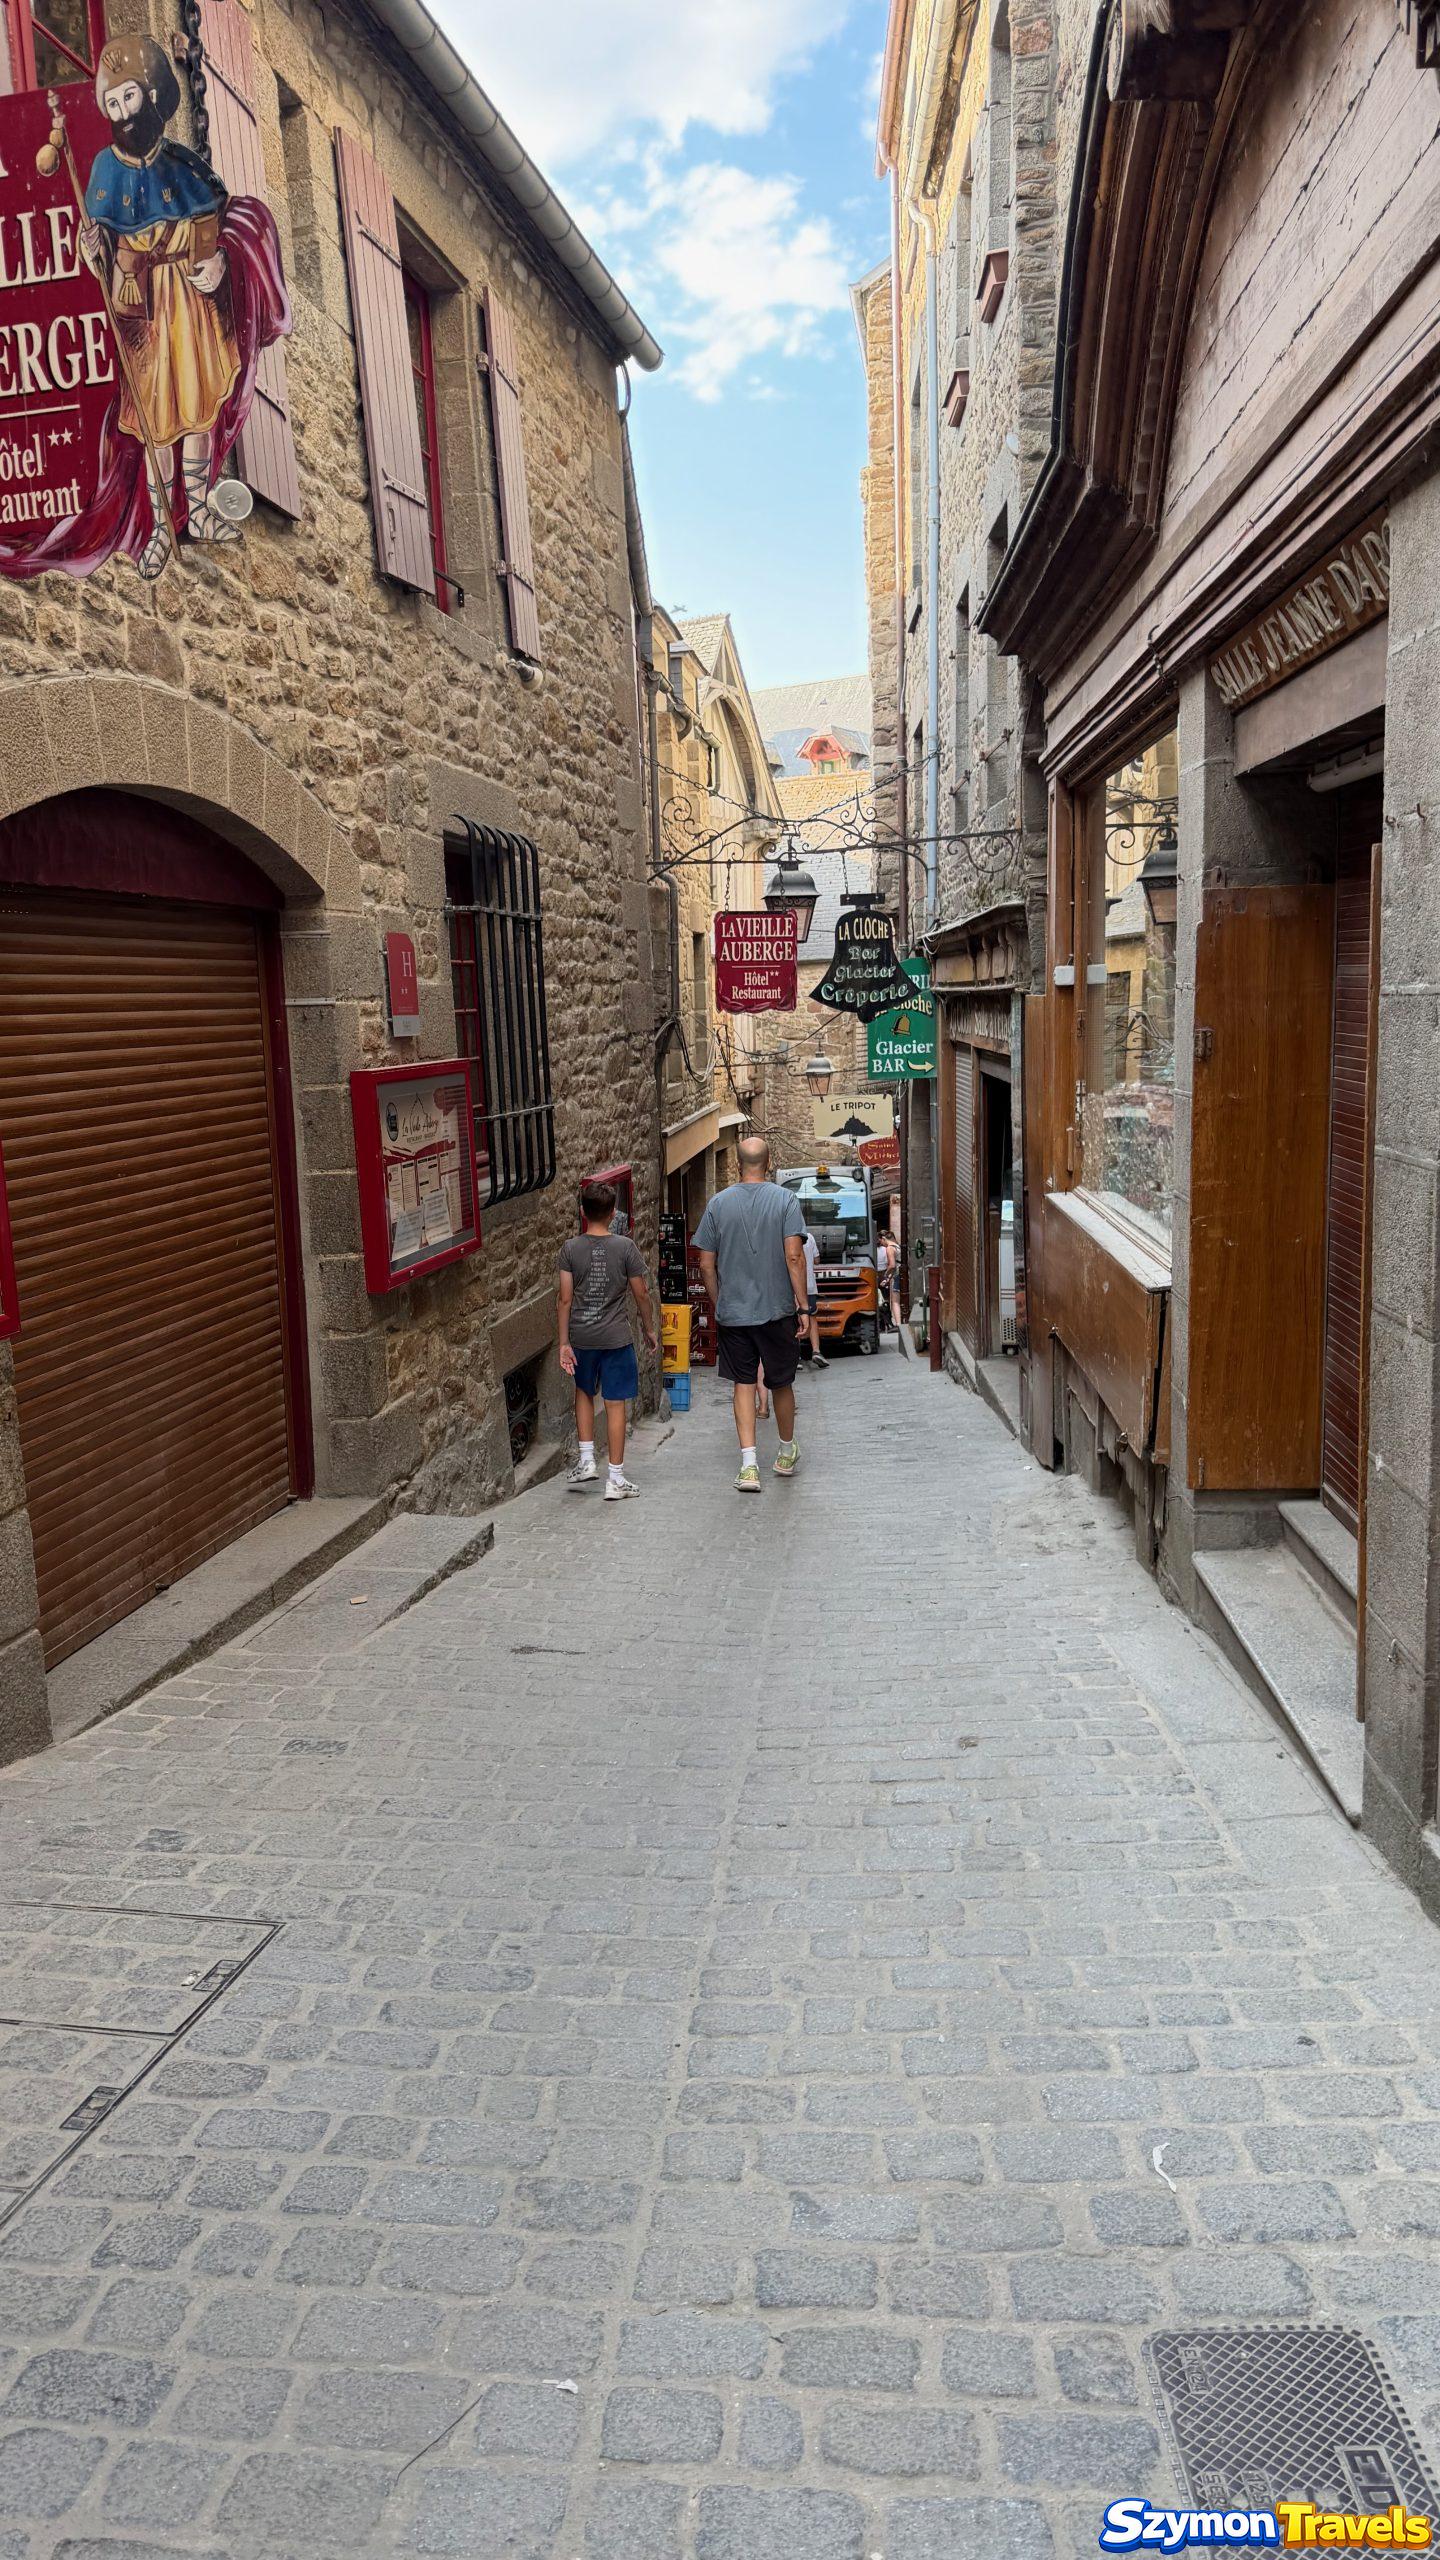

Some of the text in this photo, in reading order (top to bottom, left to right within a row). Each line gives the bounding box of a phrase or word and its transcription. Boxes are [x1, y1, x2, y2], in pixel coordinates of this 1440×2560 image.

[0, 478, 83, 524] aurant
[1210, 638, 1268, 704] SALLE
[1258, 575, 1346, 672] JEANNE
[721, 917, 794, 938] LA VIEILLE
[838, 917, 889, 940] LA CLOCHE
[719, 941, 794, 962] AUBERGE
[848, 945, 881, 960] Bar
[401, 951, 413, 977] H
[833, 964, 897, 983] Glacier
[743, 971, 769, 986] Hôtel
[731, 986, 782, 1000] Restaurant
[820, 982, 910, 1008] Crêperie
[875, 1039, 934, 1056] Glacier
[871, 1059, 906, 1074] BAR
[830, 1101, 877, 1112] LE TRIPOT
